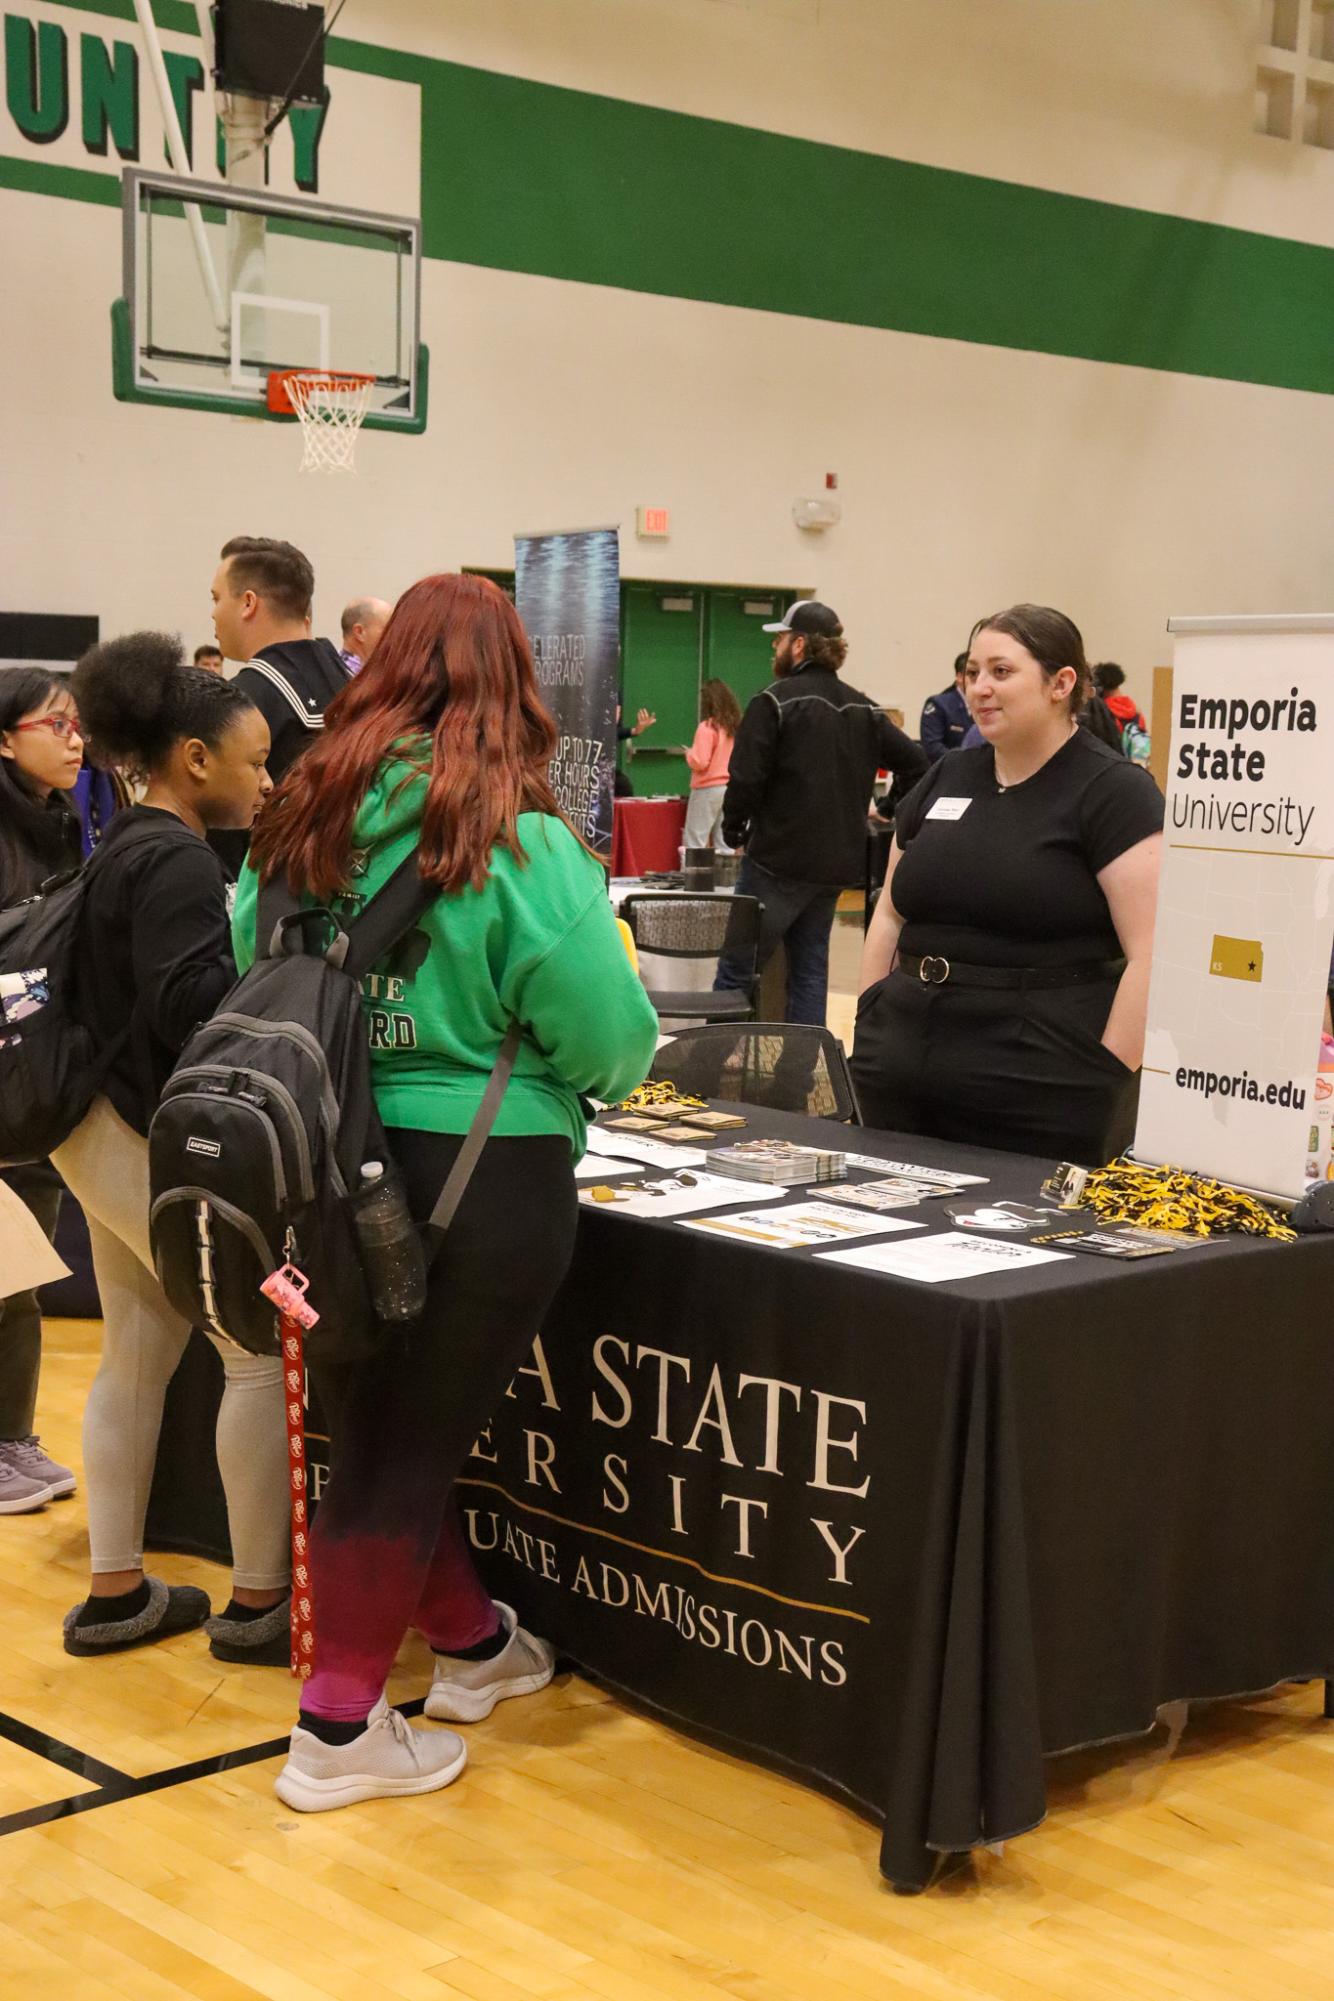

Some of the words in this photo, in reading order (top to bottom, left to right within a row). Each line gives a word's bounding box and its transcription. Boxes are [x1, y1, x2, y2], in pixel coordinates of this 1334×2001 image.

[4, 13, 331, 194] UNTY
[528, 634, 584, 660] ELERATED
[1180, 687, 1317, 740] Emporia
[555, 735, 570, 760] UP
[572, 737, 583, 762] TO
[584, 739, 603, 764] 77
[1177, 742, 1266, 782] State
[564, 761, 600, 790] HOURS
[554, 786, 599, 815] COLLEGE
[1173, 793, 1315, 846] University
[357, 973, 406, 1002] TE
[368, 1010, 417, 1049] RD
[1175, 1067, 1306, 1110] emporia.edu
[592, 1334, 871, 1499] STATE
[570, 1554, 848, 1687] ADMISSIONS
